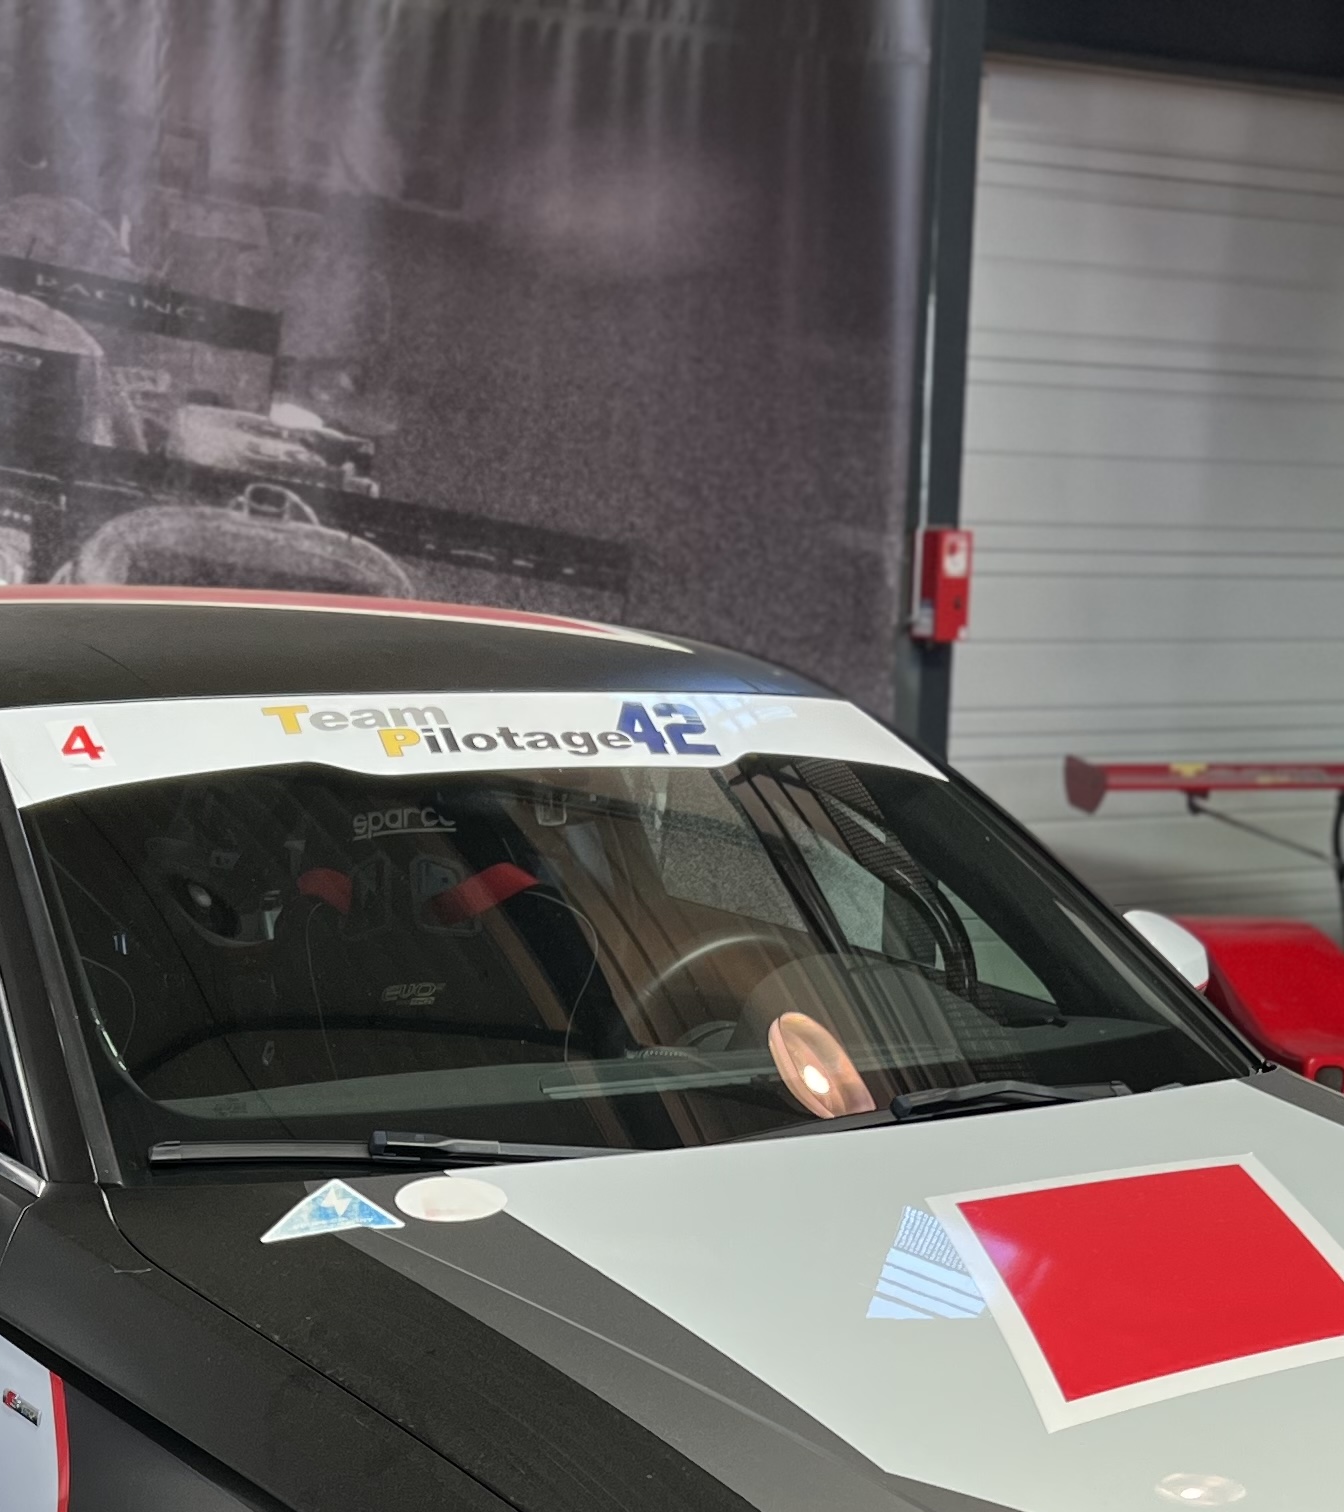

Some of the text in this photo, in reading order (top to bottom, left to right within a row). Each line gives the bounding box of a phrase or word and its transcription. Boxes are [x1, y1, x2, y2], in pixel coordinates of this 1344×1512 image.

[60, 702, 720, 761] 4 Pilotage 42
[262, 702, 449, 736] Team
